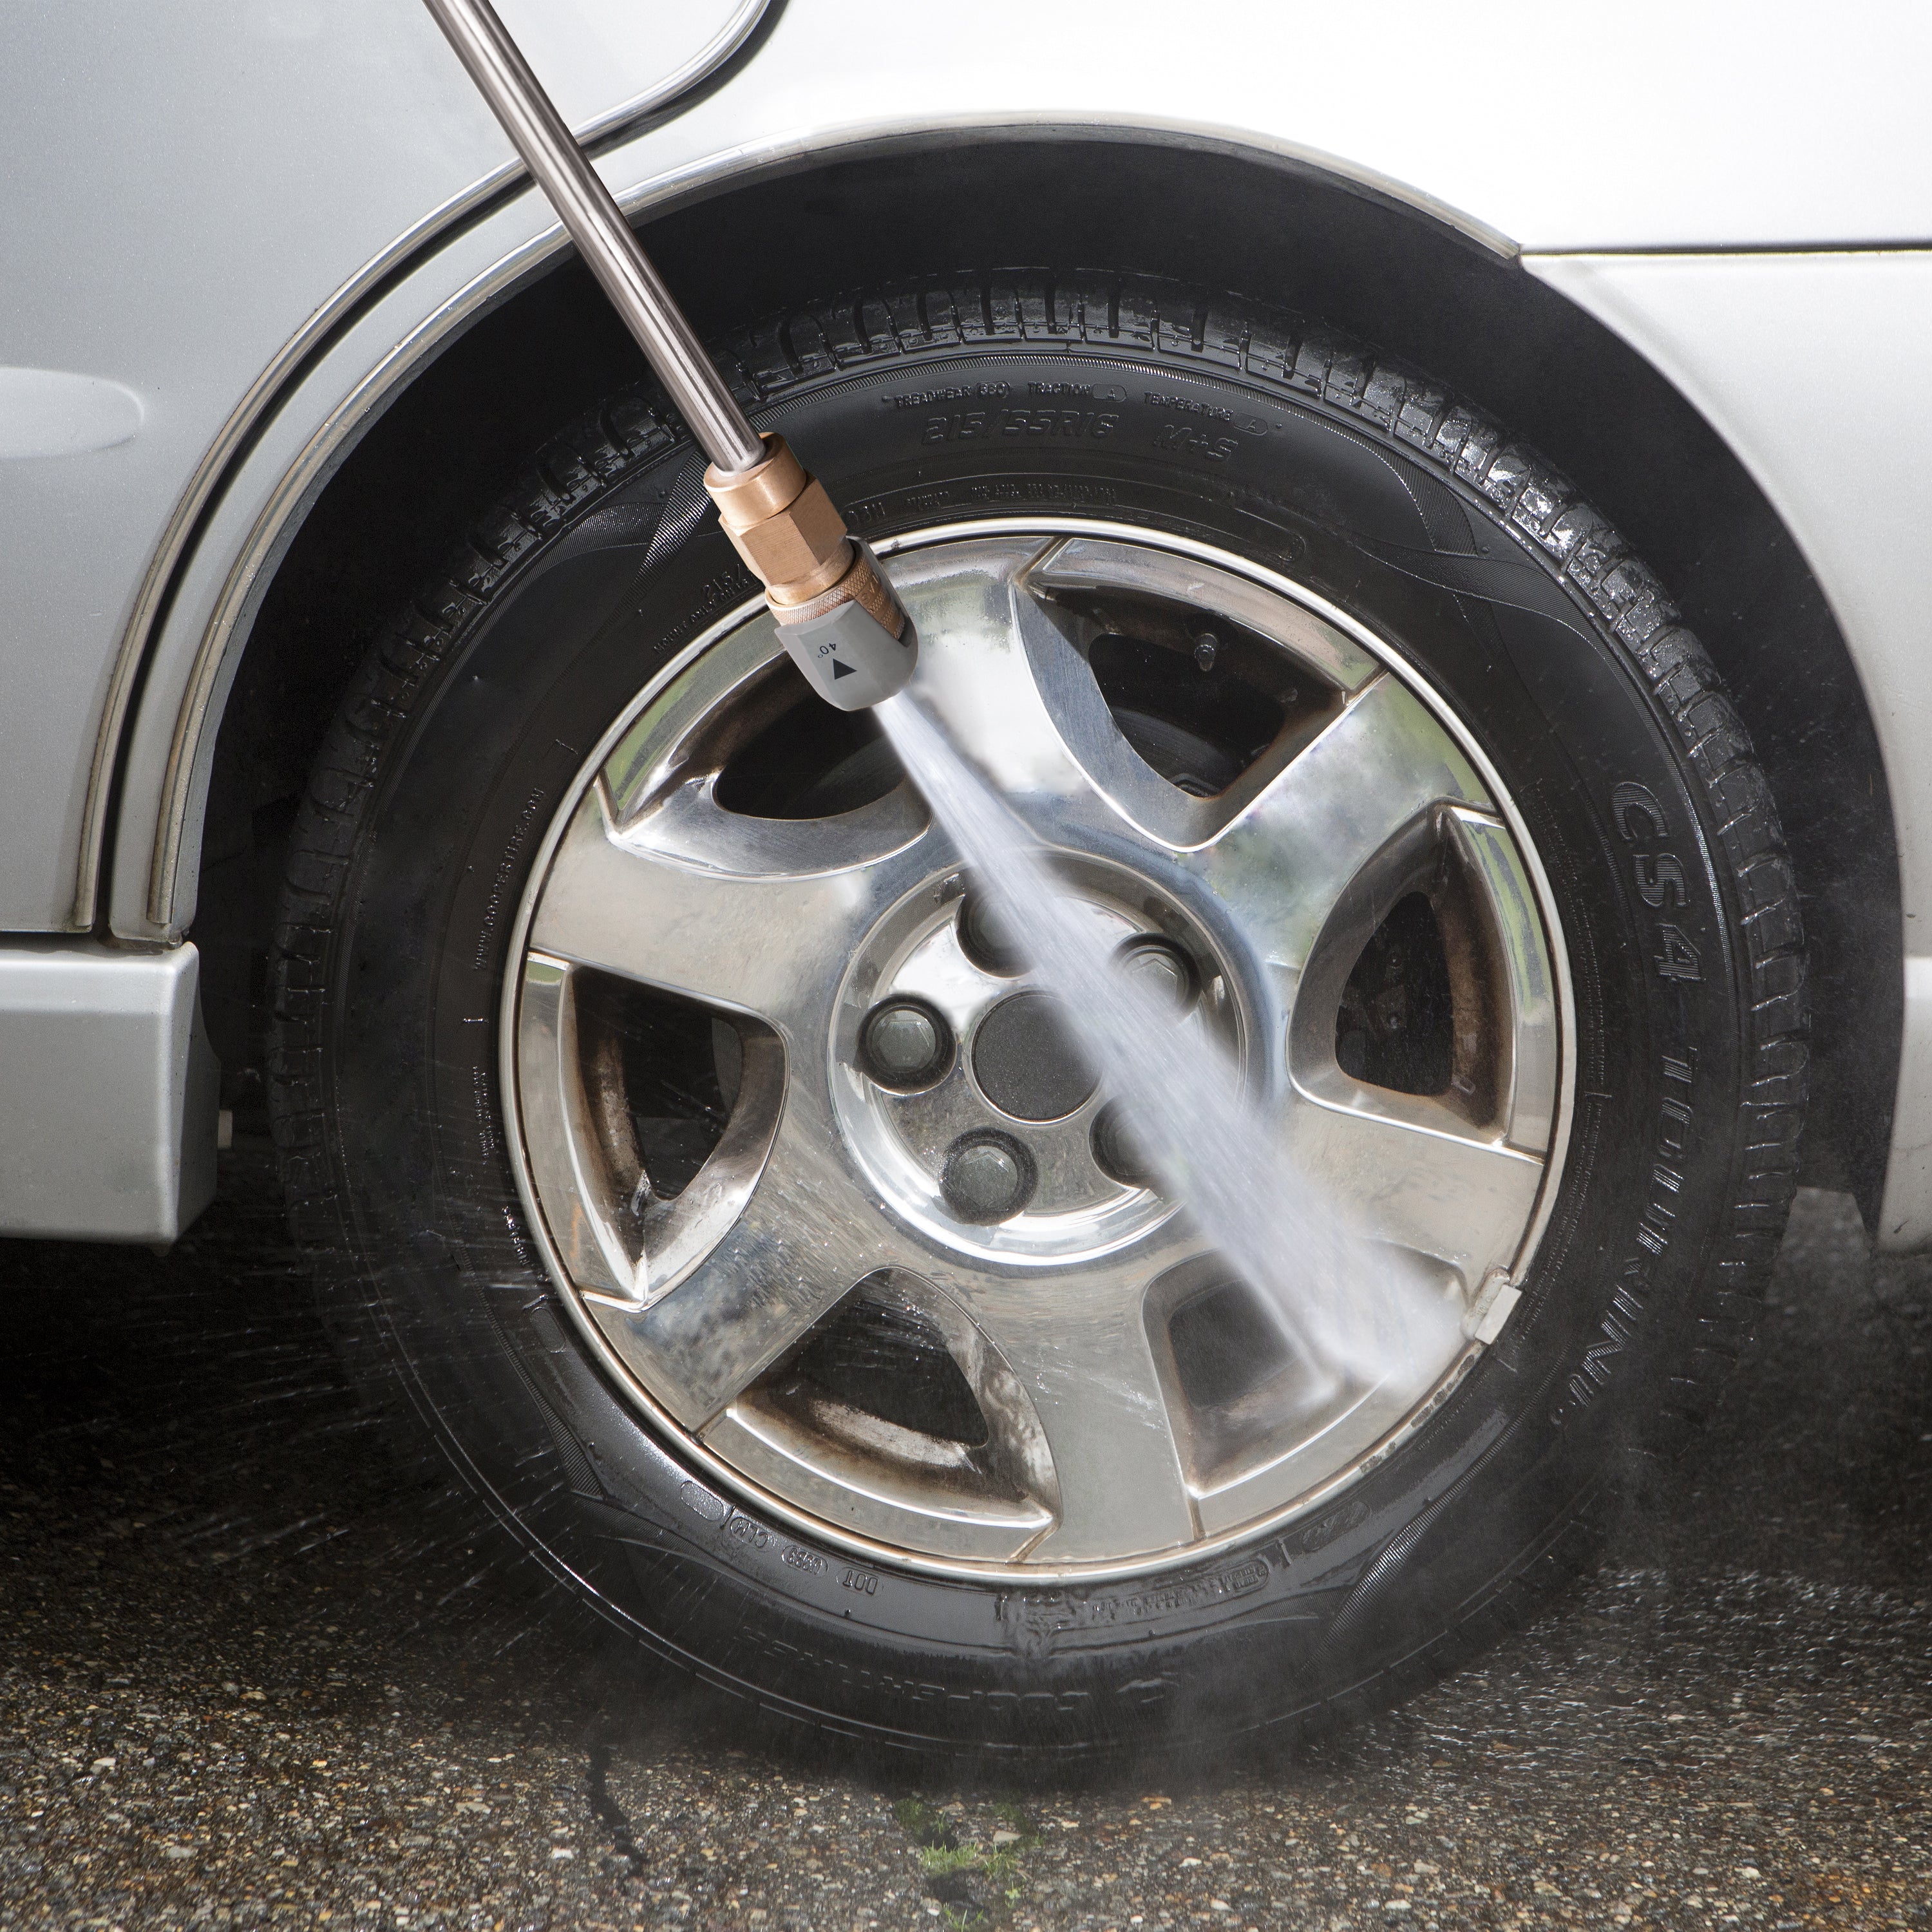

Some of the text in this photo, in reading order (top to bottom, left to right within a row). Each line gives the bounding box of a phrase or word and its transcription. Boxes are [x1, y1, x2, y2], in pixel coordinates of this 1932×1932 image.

[894, 384, 971, 408] TREADWEAR
[1028, 381, 1092, 396] TRACTION
[1143, 390, 1232, 421] TEMPERATURE
[922, 409, 1238, 462] 215/55R16 M+S
[817, 642, 837, 659] 40°
[474, 786, 544, 971] WWW.COOPERTIRE.COM
[1611, 780, 1705, 985] CS4
[842, 1570, 878, 1595] DOT
